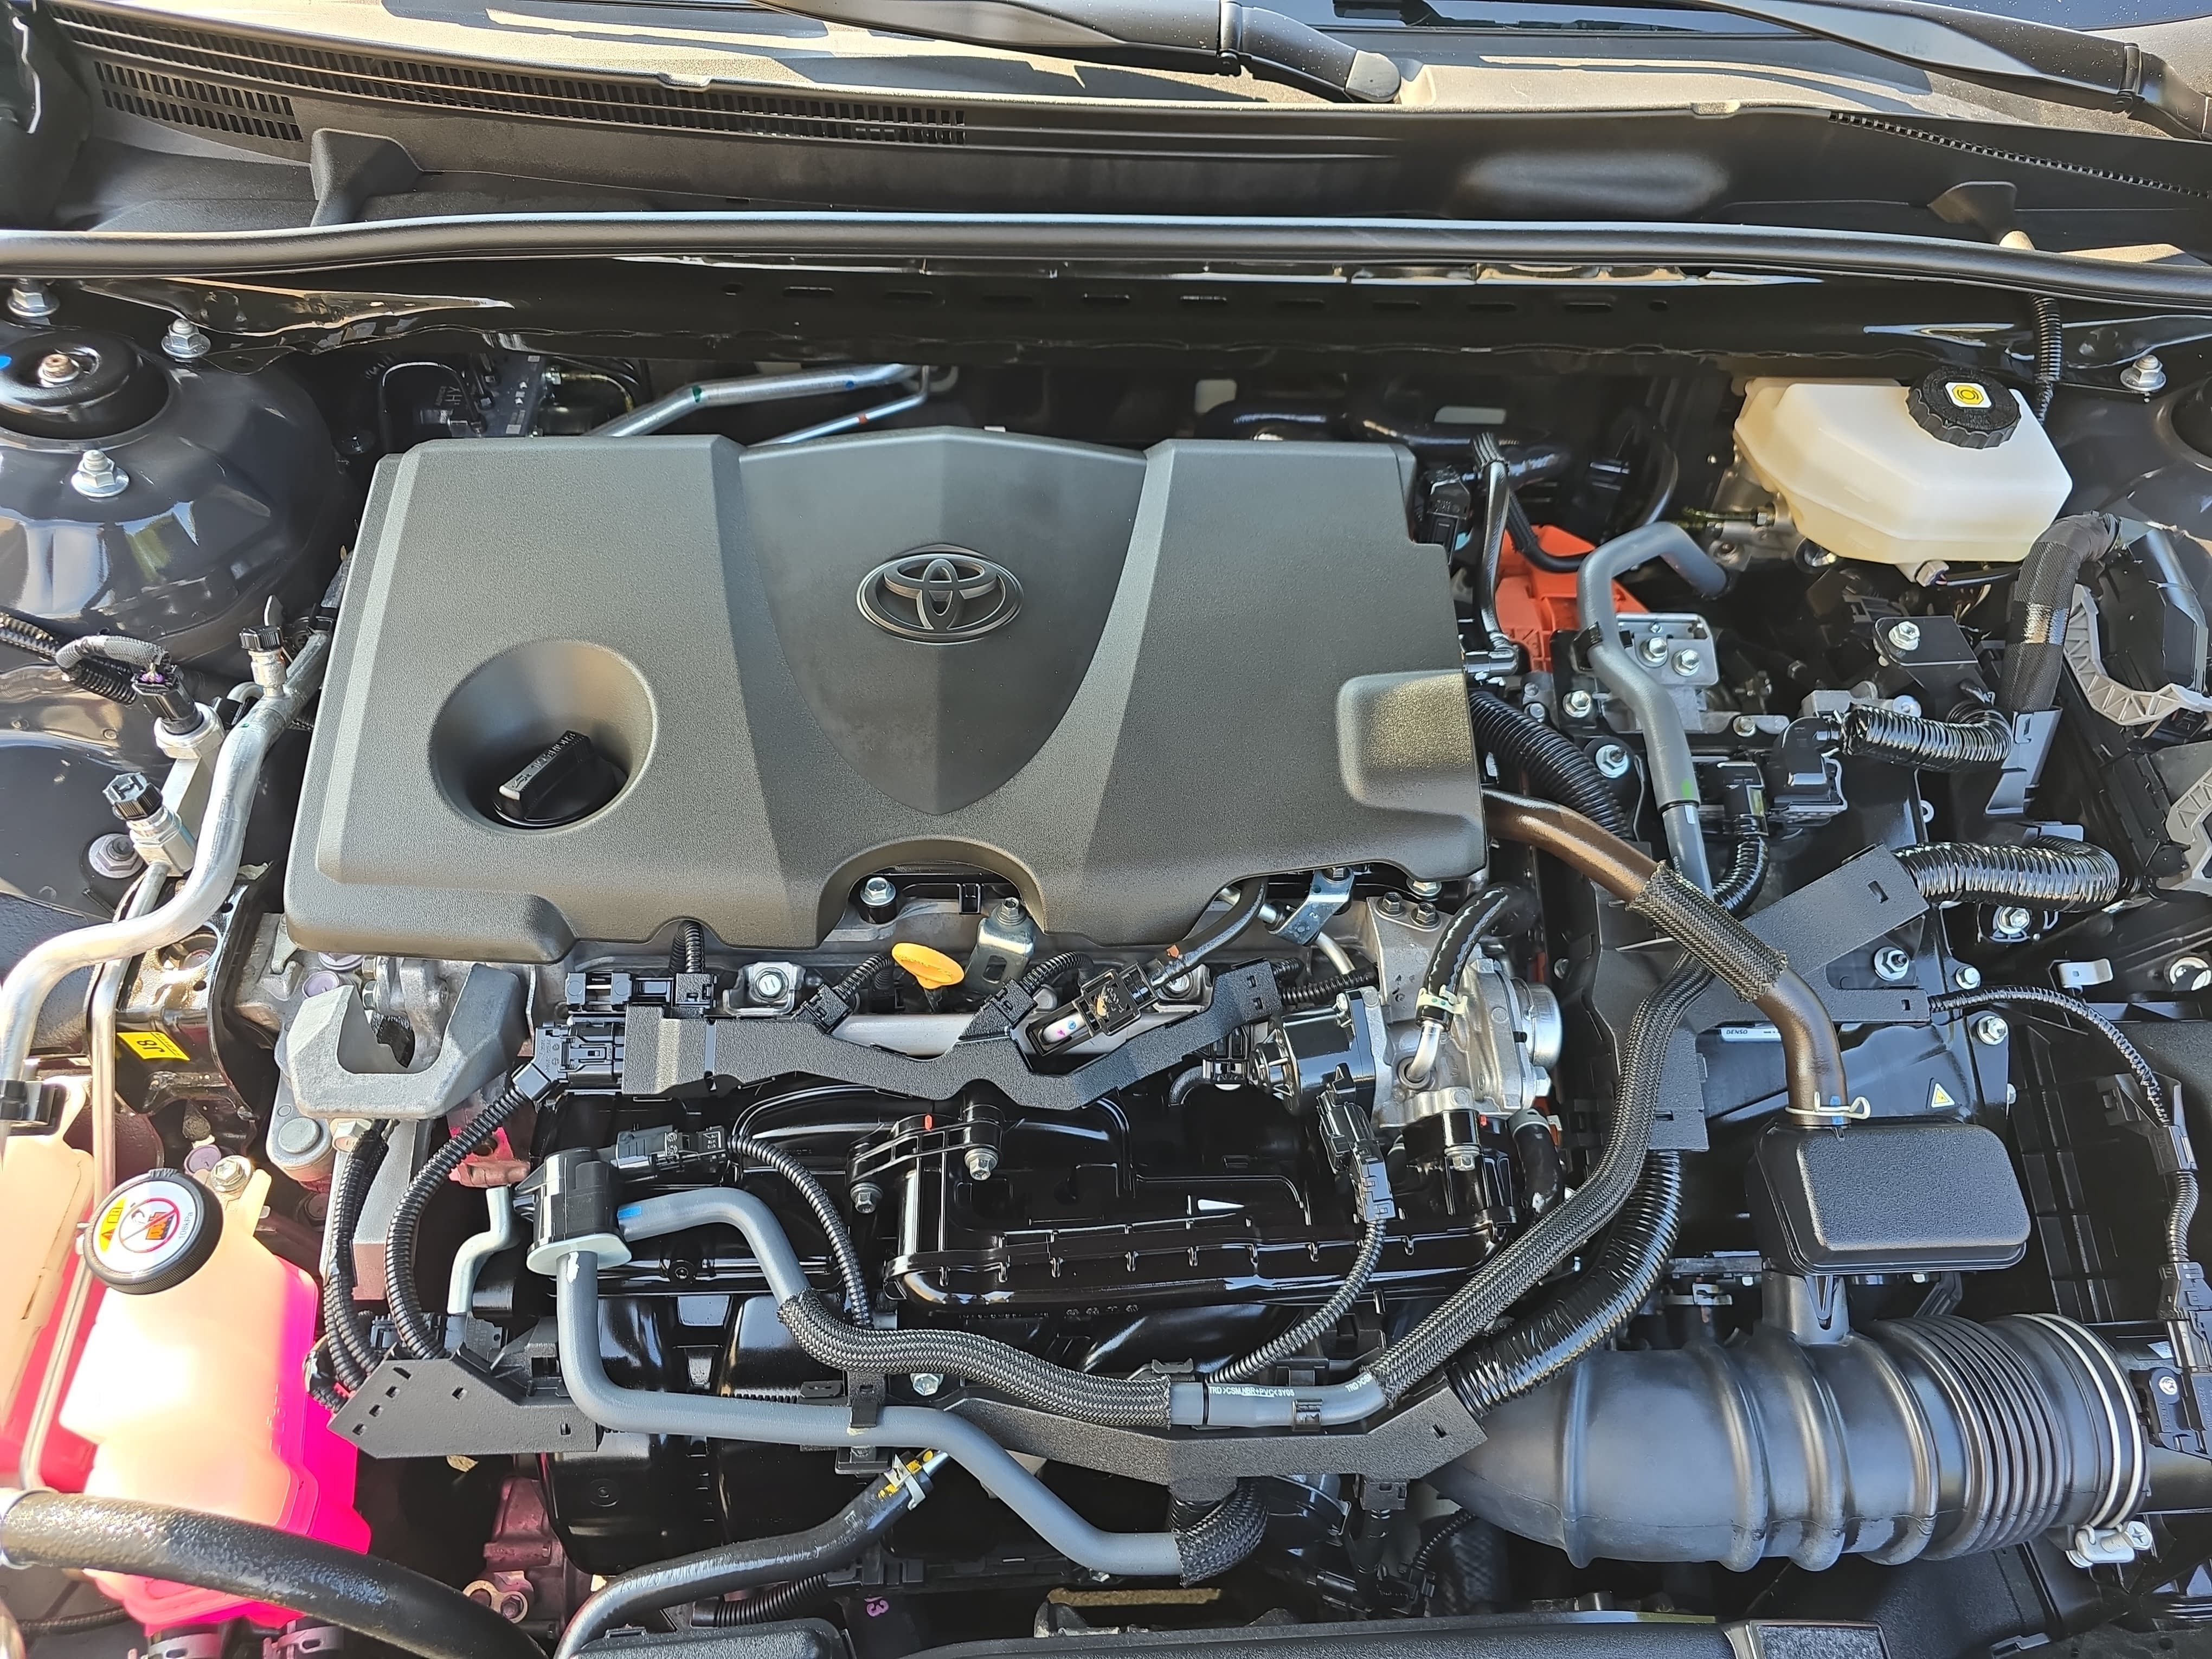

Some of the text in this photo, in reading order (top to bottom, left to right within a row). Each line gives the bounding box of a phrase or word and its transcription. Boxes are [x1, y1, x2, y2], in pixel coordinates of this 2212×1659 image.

[136, 1040, 165, 1053] J8
[150, 1169, 177, 1178] ITW
[178, 1211, 194, 1240] 108kPa
